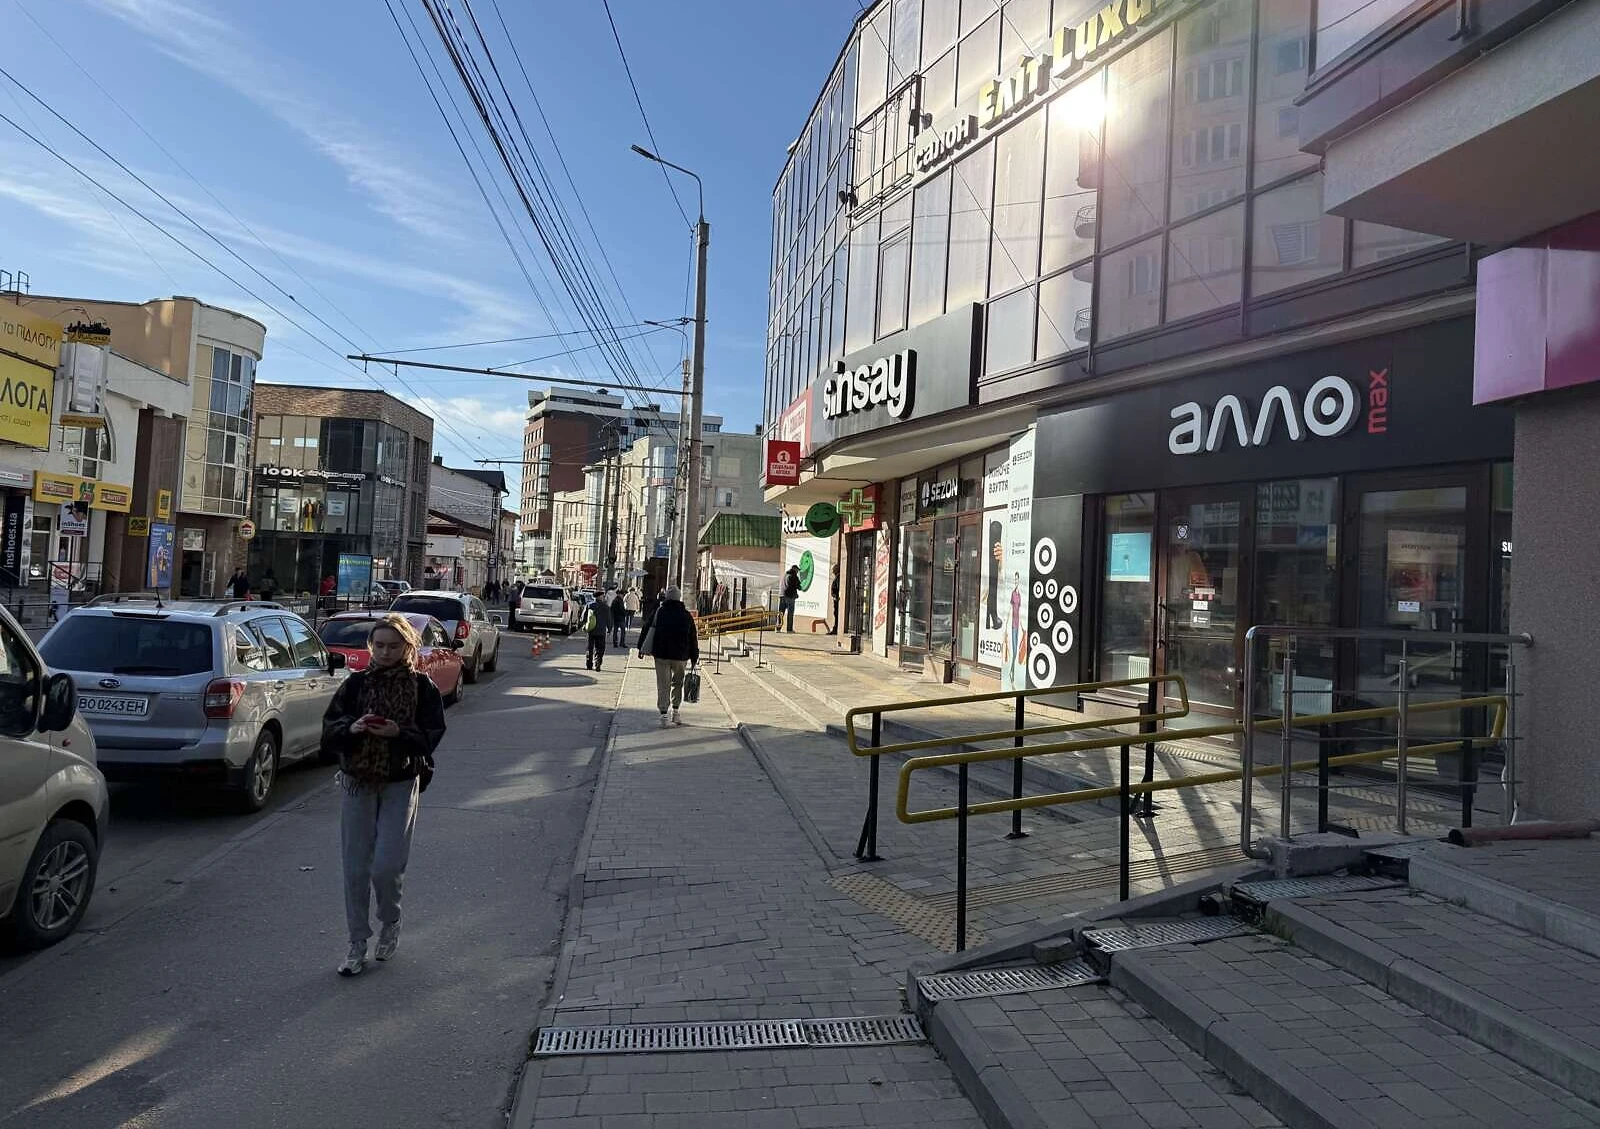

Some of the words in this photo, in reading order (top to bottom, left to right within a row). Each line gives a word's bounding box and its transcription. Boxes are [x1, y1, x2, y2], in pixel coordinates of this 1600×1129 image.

[16, 324, 56, 352] ПІДЛОГИ
[822, 348, 909, 420] sinsay
[1368, 368, 1388, 434] max
[931, 477, 958, 502] SEZON
[988, 480, 1009, 494] ВЗУТТЯ
[4, 512, 18, 569] inshoes.ua
[986, 640, 1003, 654] SEZO
[98, 698, 126, 712] 0243
[127, 702, 145, 713] EH
